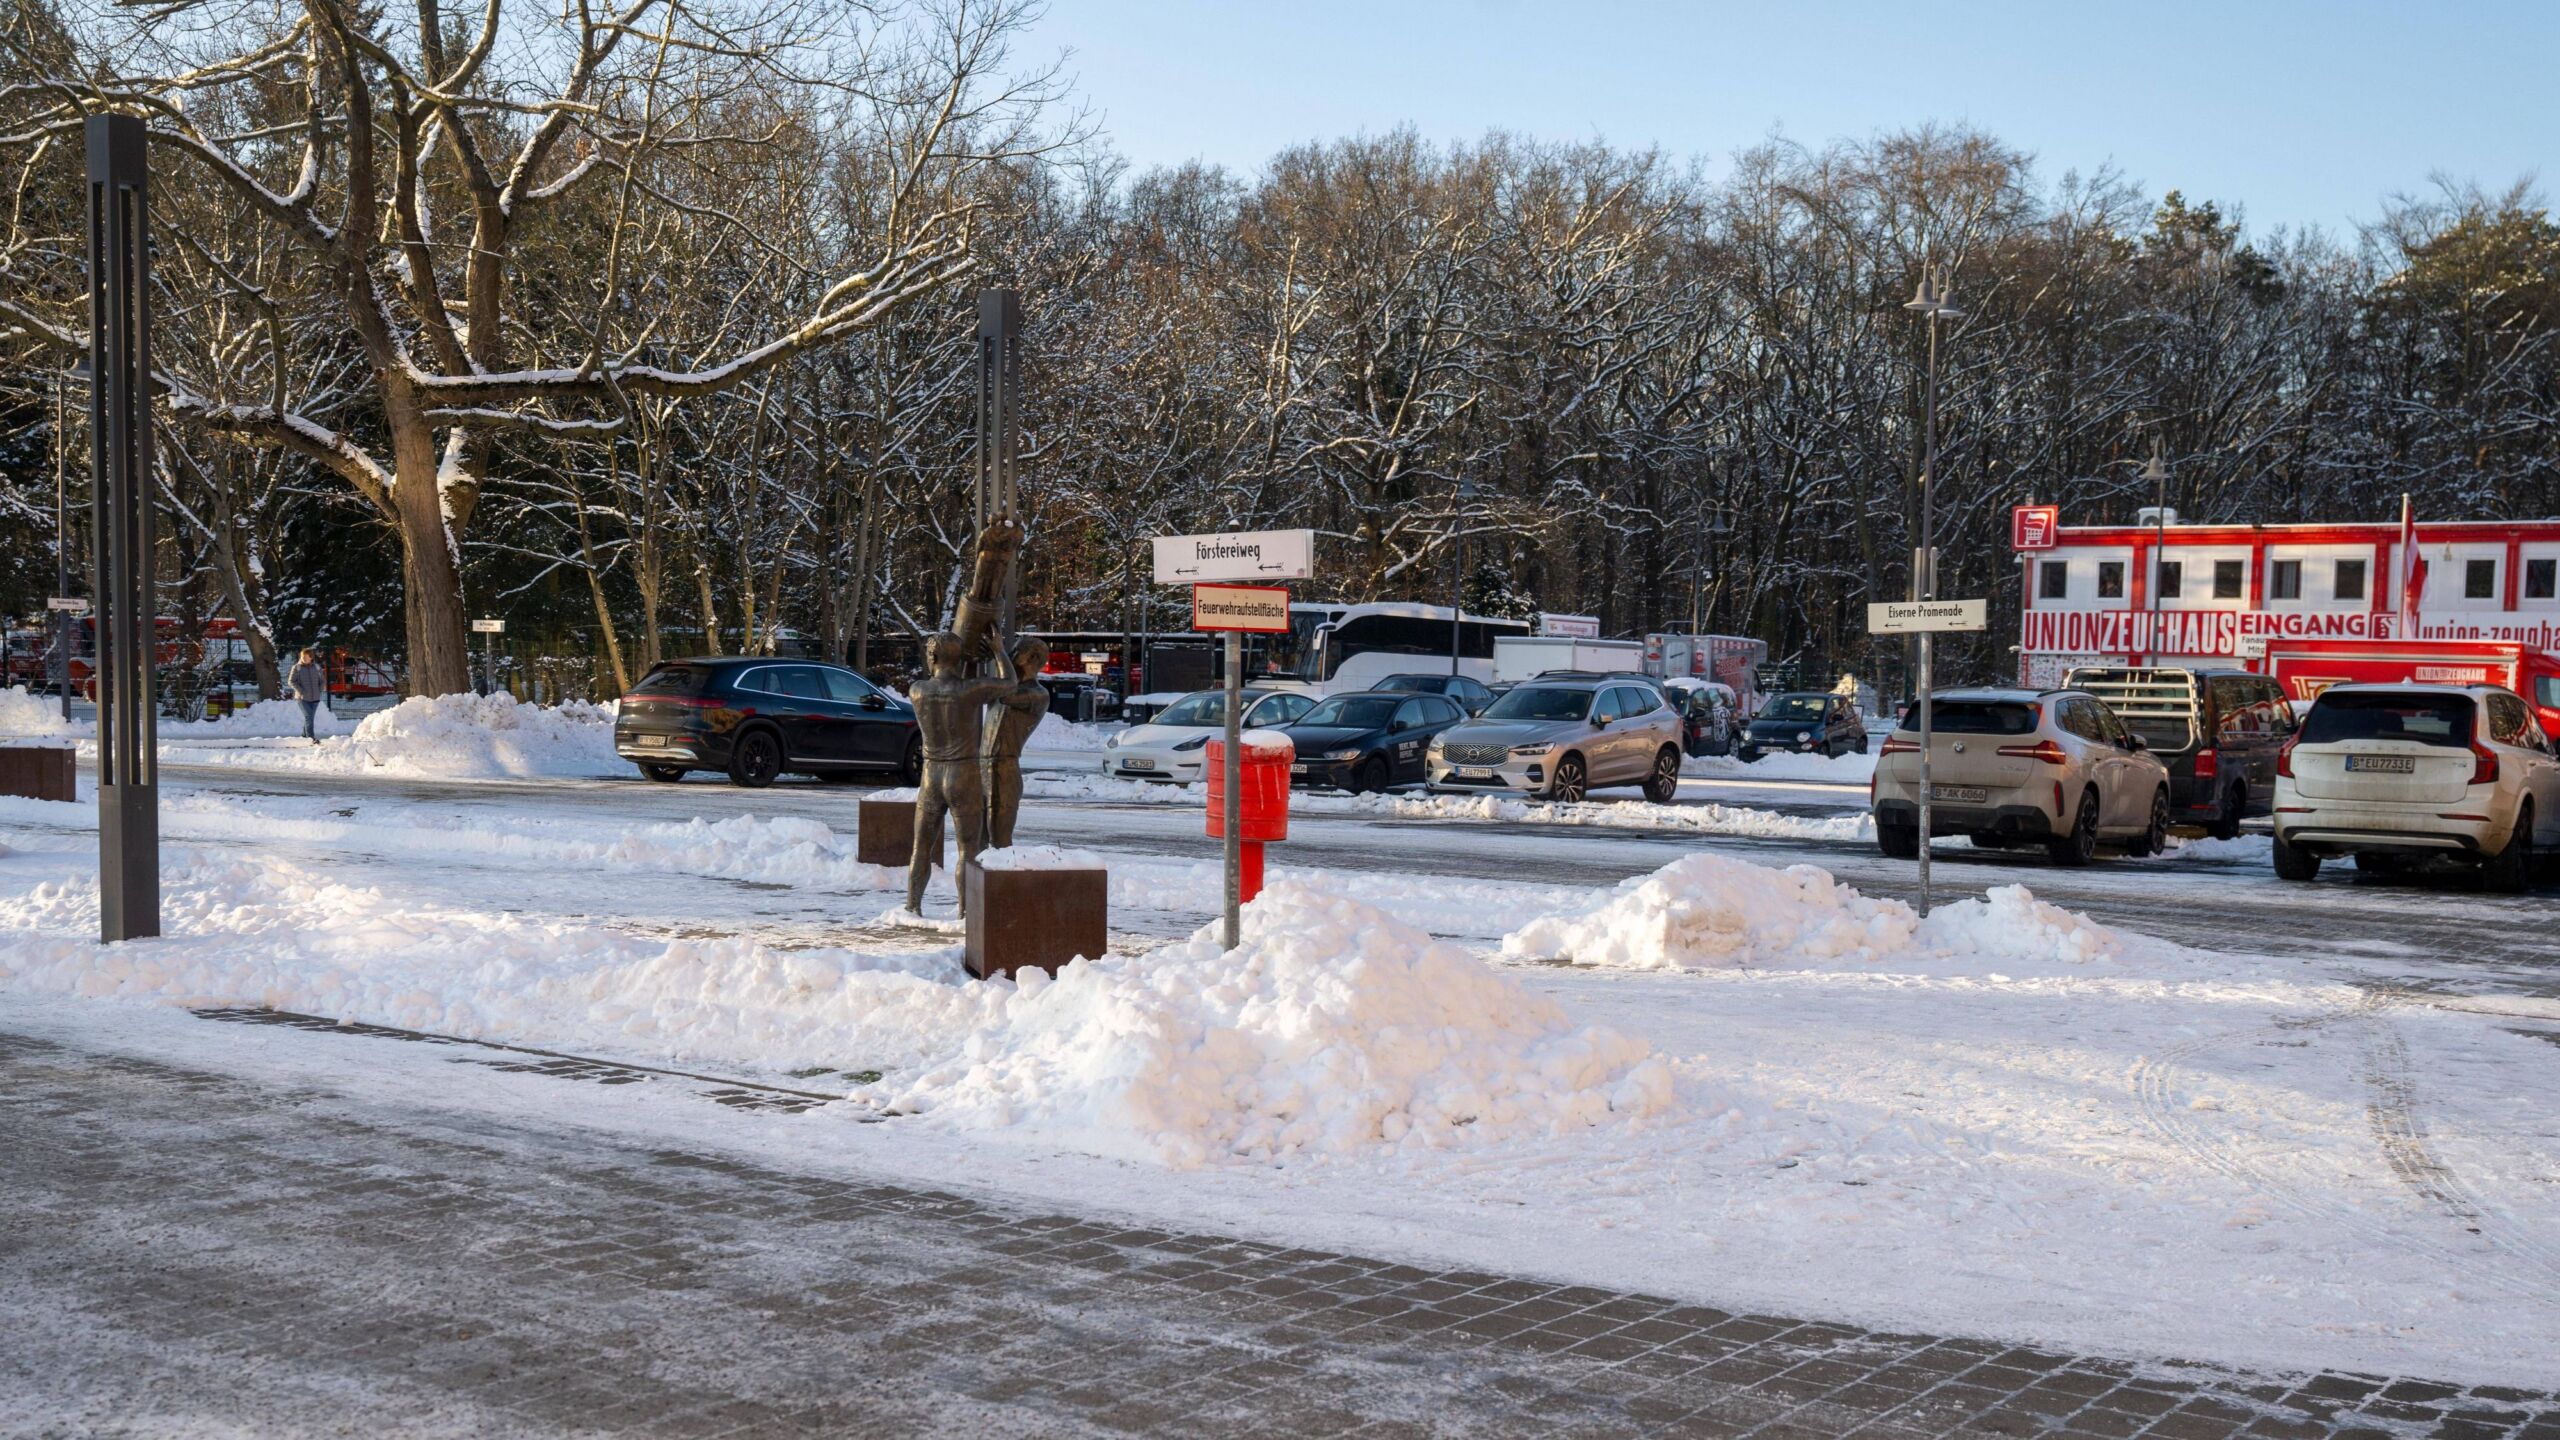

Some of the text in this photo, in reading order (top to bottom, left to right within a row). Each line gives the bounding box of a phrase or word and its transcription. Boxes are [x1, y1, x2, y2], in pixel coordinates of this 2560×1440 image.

[1196, 542, 1260, 561] Förstereiweg
[1198, 599, 1284, 618] Feuerwehraufstellfläche
[1888, 604, 1963, 618] Eiserne Promenade
[2240, 614, 2365, 635] EINGANG
